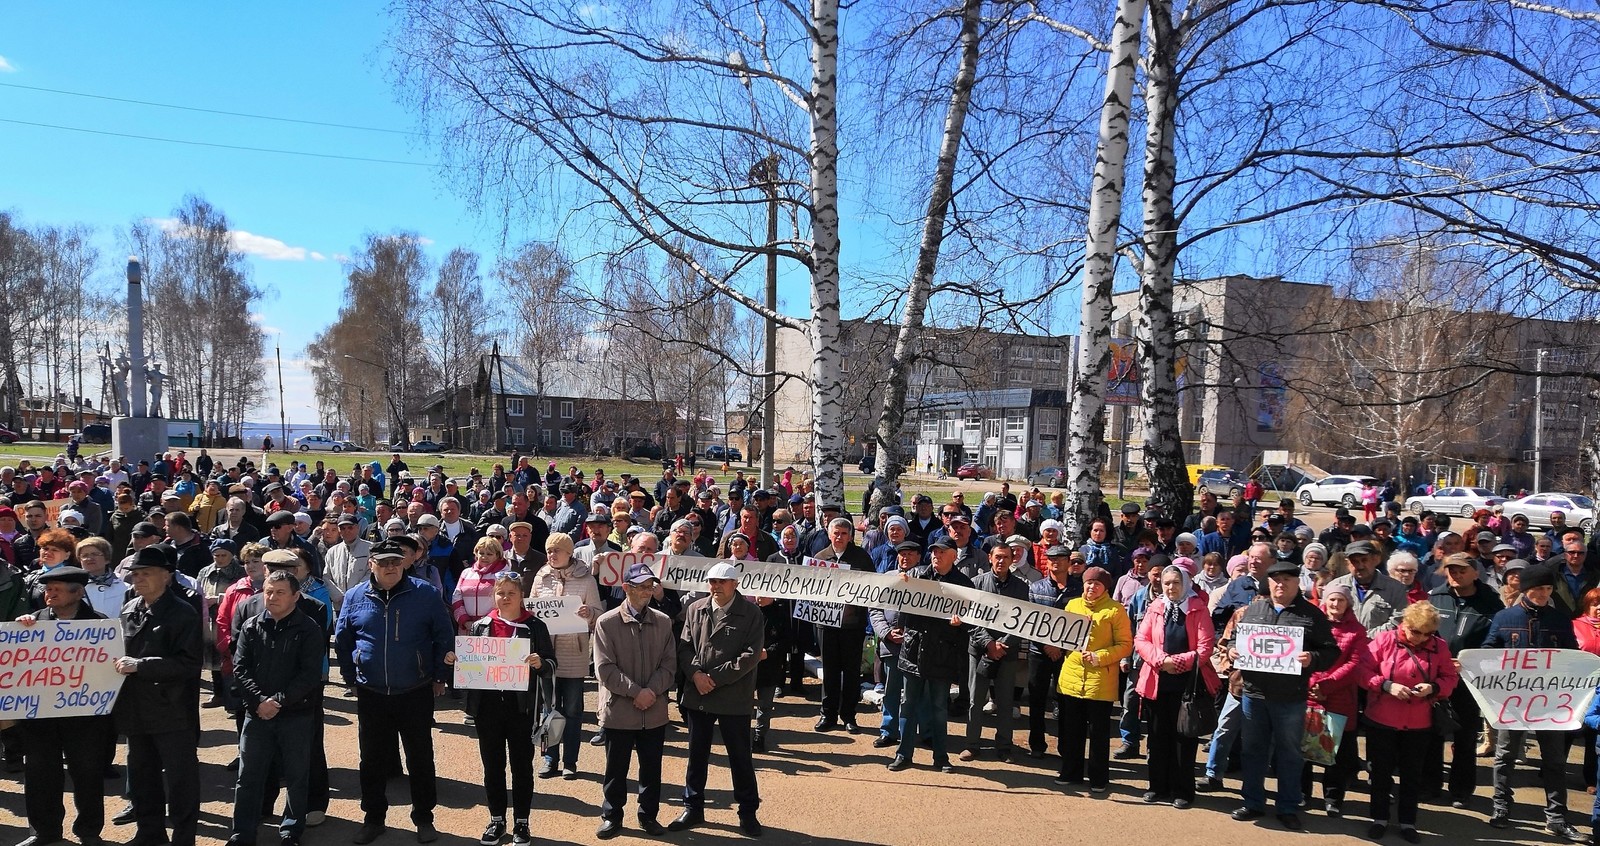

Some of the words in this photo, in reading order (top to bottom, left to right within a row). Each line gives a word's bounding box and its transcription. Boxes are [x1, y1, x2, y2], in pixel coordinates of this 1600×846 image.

[525, 600, 565, 611] #СПАСТИ
[796, 603, 841, 626] ЗАВОДА
[837, 581, 1000, 623] судостроительный
[1003, 606, 1092, 652] ЗАВОД!
[54, 621, 117, 645] былую
[1236, 623, 1304, 638] УНИЧТОЖЕНИЮ
[465, 637, 507, 658] ЗАВОД
[1252, 638, 1291, 655] НЕТ
[1239, 655, 1296, 672] ЗАВОДА
[1501, 649, 1561, 671] НЕТ
[486, 664, 529, 683] РАБОТА
[1498, 693, 1575, 725] ССЗ
